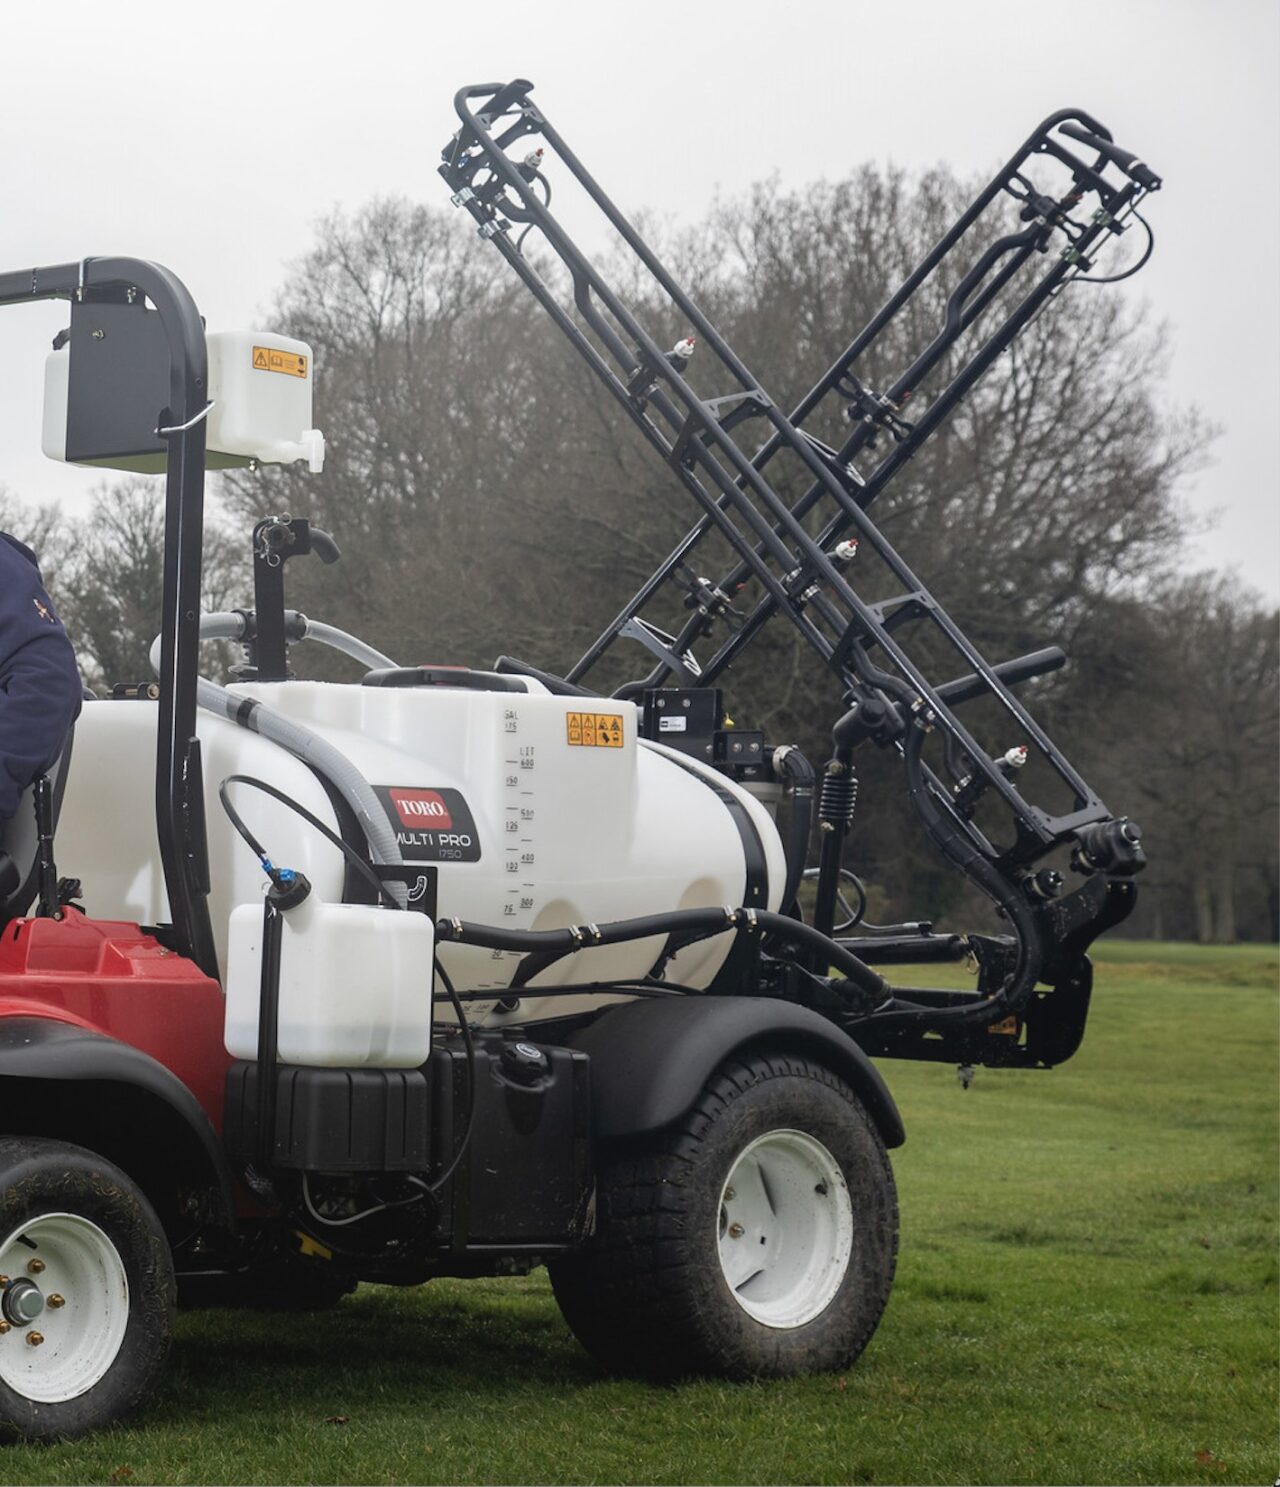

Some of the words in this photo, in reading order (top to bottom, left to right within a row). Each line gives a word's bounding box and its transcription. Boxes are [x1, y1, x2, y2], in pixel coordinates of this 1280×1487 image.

[397, 799, 445, 816] TORO
[438, 834, 472, 847] PRO
[439, 849, 462, 859] 1750
